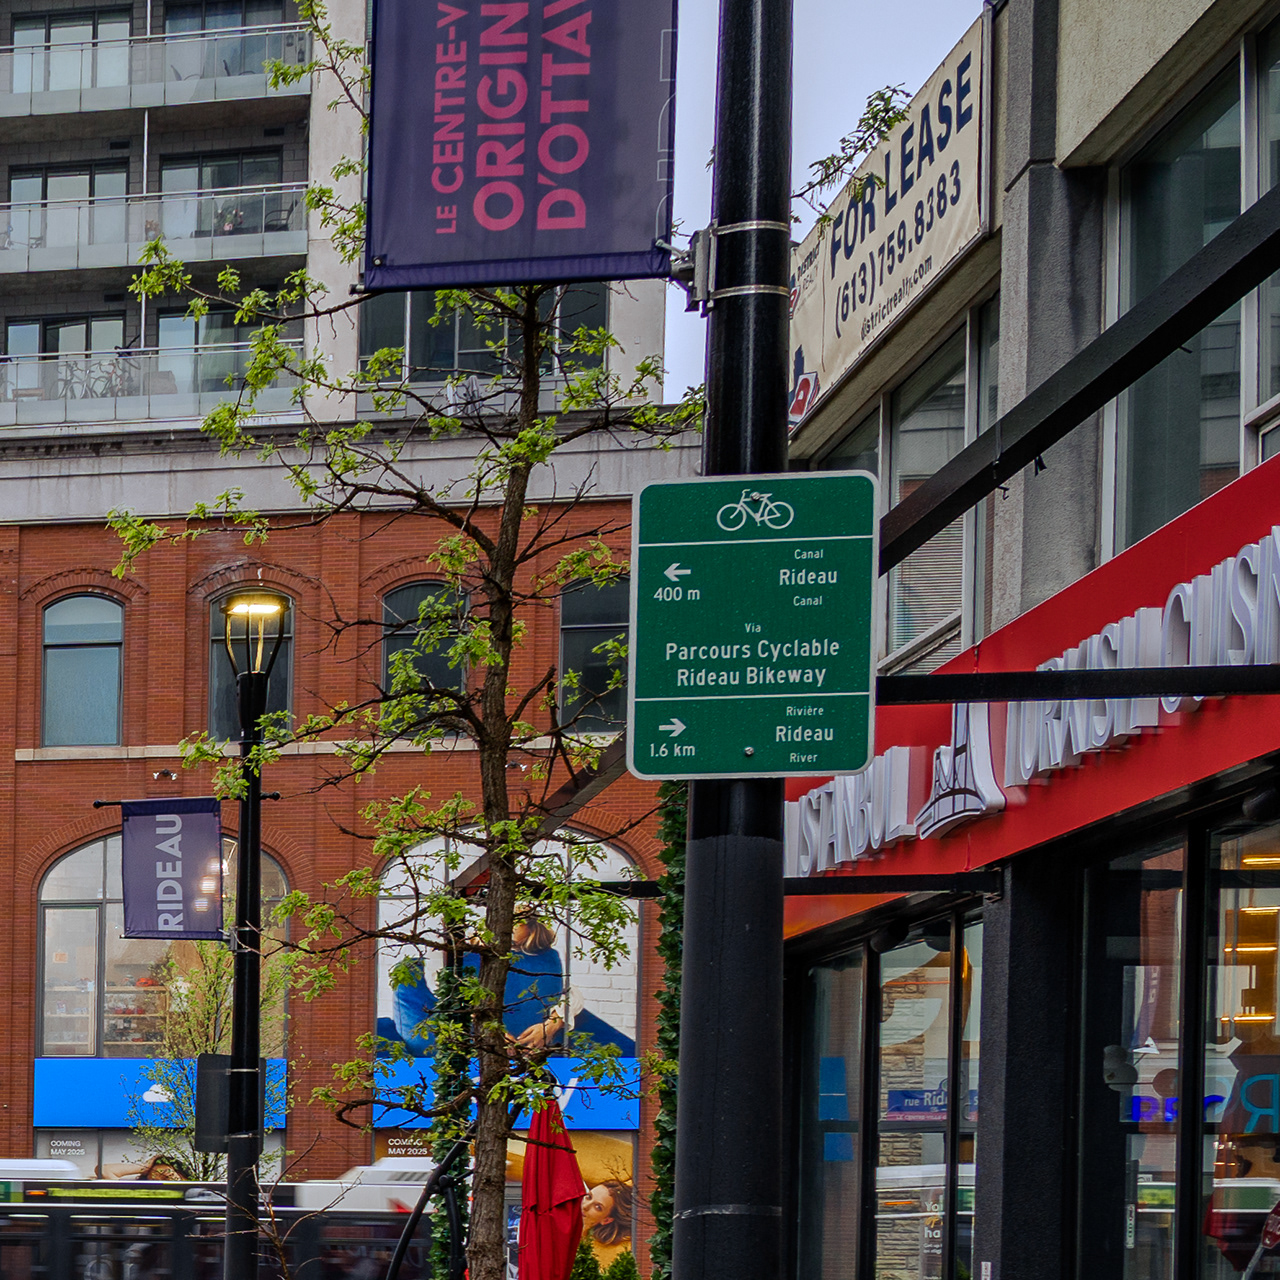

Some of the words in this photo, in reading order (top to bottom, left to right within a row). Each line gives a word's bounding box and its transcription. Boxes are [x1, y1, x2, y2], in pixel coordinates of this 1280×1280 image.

[831, 172, 876, 280] FOR
[884, 51, 974, 217] LEASE
[436, 204, 457, 234] LE
[835, 159, 961, 339] (613)759.8383
[794, 549, 824, 560] Canal
[779, 568, 838, 585] Rideau
[653, 587, 683, 601] 400
[687, 588, 701, 600] m
[793, 595, 823, 606] Canal
[744, 622, 762, 633] Via
[665, 642, 751, 660] Parcours
[757, 638, 840, 662] Cyclable
[677, 668, 740, 687] Rideau
[746, 667, 827, 687] Bikeway
[786, 705, 824, 717] Rivière
[775, 725, 834, 742] Rideau
[649, 743, 669, 757] 1.6
[673, 743, 696, 756] km
[789, 752, 818, 763] River
[155, 814, 184, 931] RIDEAU
[904, 1098, 920, 1106] rue
